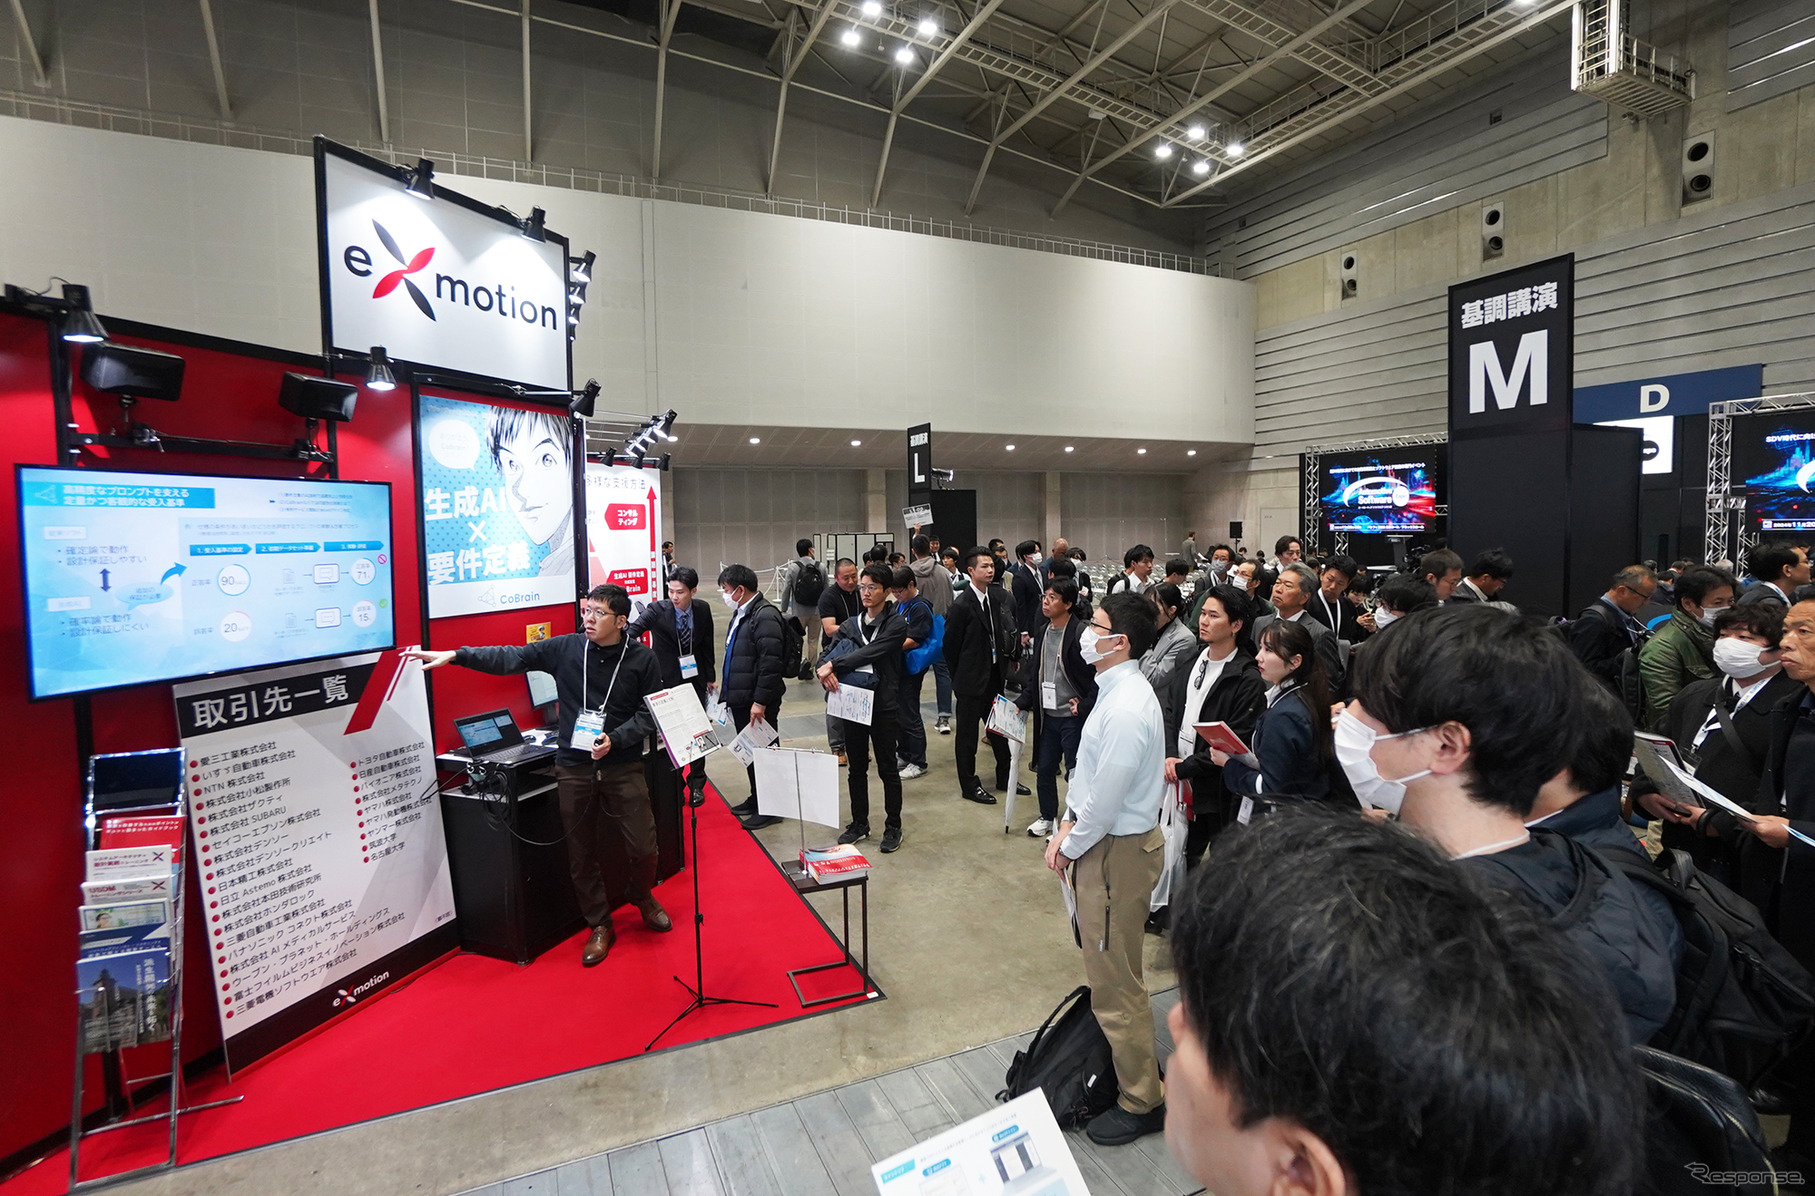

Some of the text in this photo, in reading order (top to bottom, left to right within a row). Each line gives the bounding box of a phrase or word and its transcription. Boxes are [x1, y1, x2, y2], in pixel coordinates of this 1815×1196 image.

[1461, 281, 1559, 330] 基調講演
[1469, 329, 1548, 414] M
[1640, 383, 1670, 413] D
[914, 453, 925, 483] L
[424, 486, 505, 521] 生成AI
[617, 509, 638, 517] コンサル
[427, 540, 531, 585] 要件定義
[500, 591, 540, 605] CoBrain
[193, 674, 349, 729] 取引先一覧
[200, 741, 277, 767] 愛三工業株式会社
[359, 742, 425, 766] トヨタ自動車株式会社
[359, 755, 421, 779] 日産自動車株式会社
[204, 771, 266, 795] NTN 株式会社
[206, 777, 291, 808] 株式会社小松製作所
[361, 766, 422, 791] パイオニア株式会社
[362, 777, 422, 802] 株式会社メタテクノ
[208, 795, 283, 822] 株式会社ザクティ
[364, 792, 412, 814] ヤマハ株式会社
[366, 797, 433, 825] ヤマハ発動機株式会社
[210, 806, 287, 836] 株式会社 SUBARU
[212, 808, 321, 850] セイコーエプソン株式会社
[367, 812, 422, 837] ヤンマー株式会社
[214, 834, 289, 864] 株式会社デンソー
[216, 831, 332, 878] 株式会社デンソークリエイト
[369, 833, 397, 849] 筑波大学
[371, 842, 405, 861] 名古屋大学
[219, 858, 293, 892] 日本精工株式会社
[221, 864, 312, 906] 日立 Astemo 株式会社
[222, 873, 322, 919] 株式会社本田技術研究所
[224, 889, 315, 933] 株式会社ホンダロック
[226, 898, 325, 947] 三菱自動車工業株式会社
[229, 899, 353, 960] パナソニック コネクト株式会社
[230, 951, 268, 974] 株式会社
[283, 910, 356, 950] メディカルサービス
